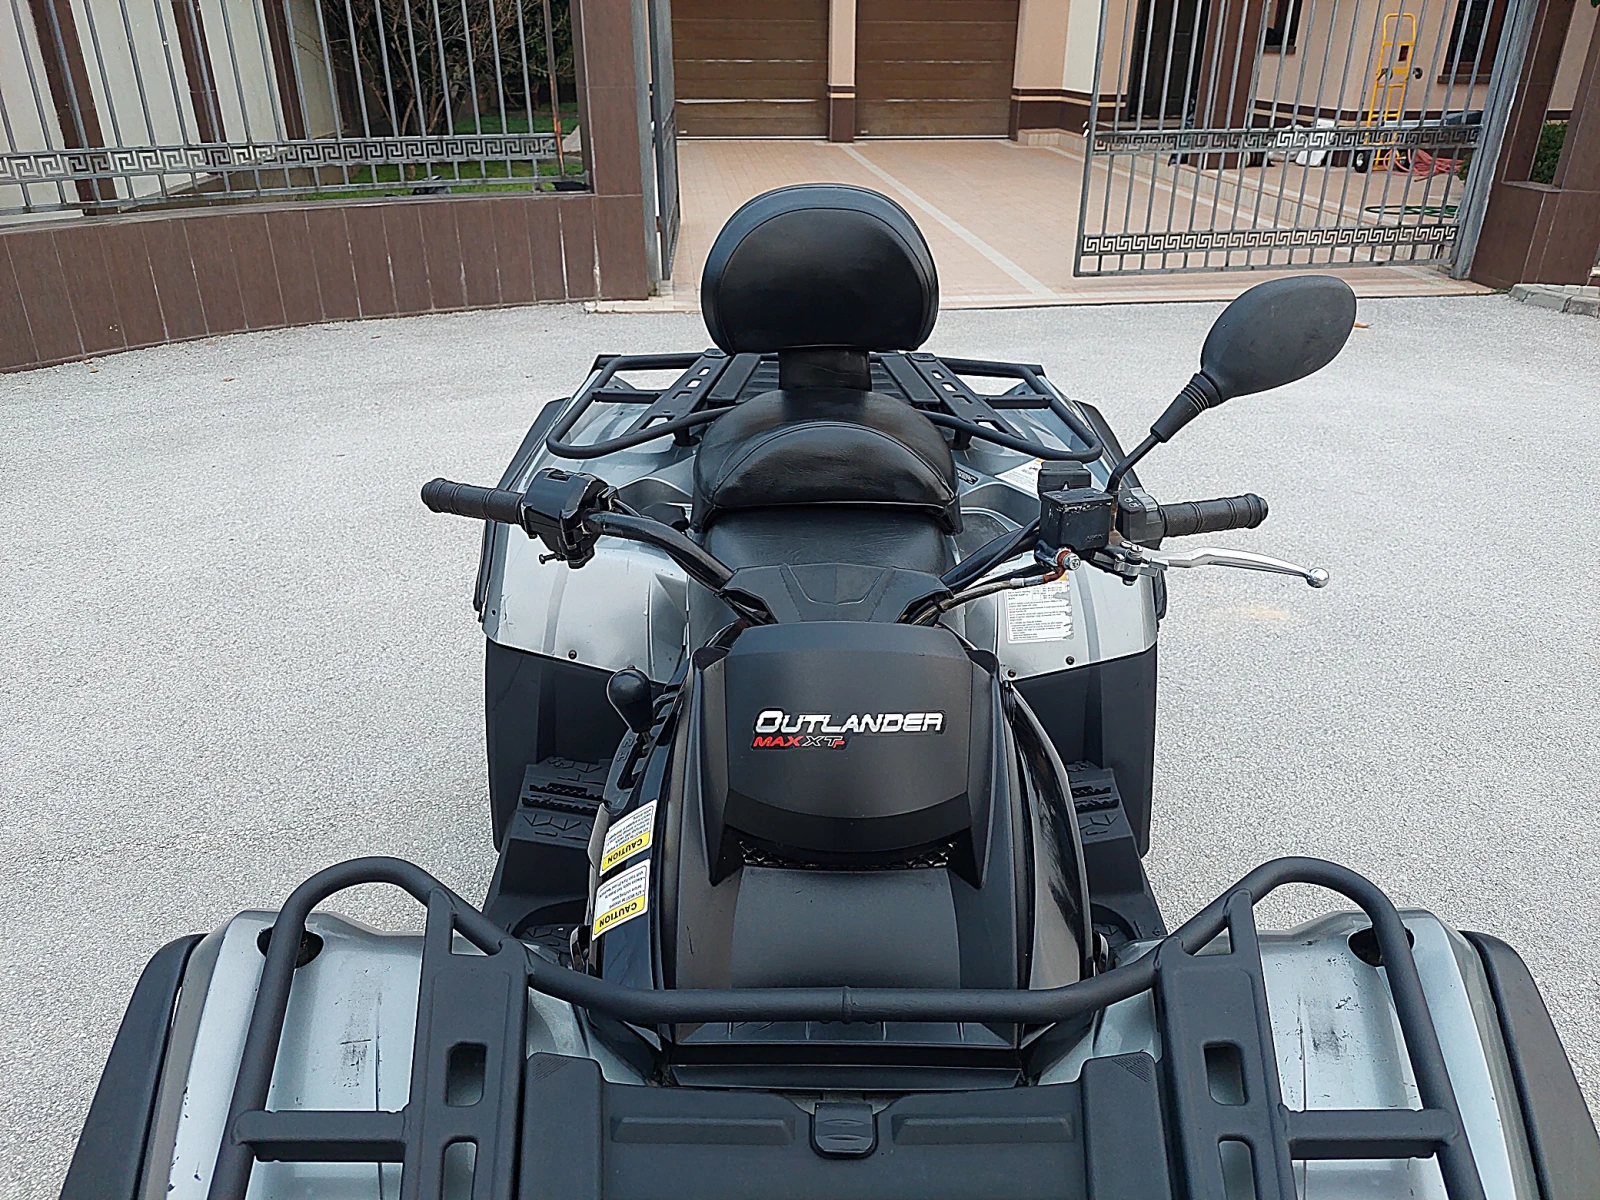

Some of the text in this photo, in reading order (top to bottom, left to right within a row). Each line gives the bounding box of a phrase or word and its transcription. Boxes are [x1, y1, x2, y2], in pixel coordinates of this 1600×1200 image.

[755, 710, 942, 732] OUTLANDER
[753, 736, 802, 747] MAX
[607, 838, 643, 864] CAUTION
[599, 902, 638, 928] CAUTION
